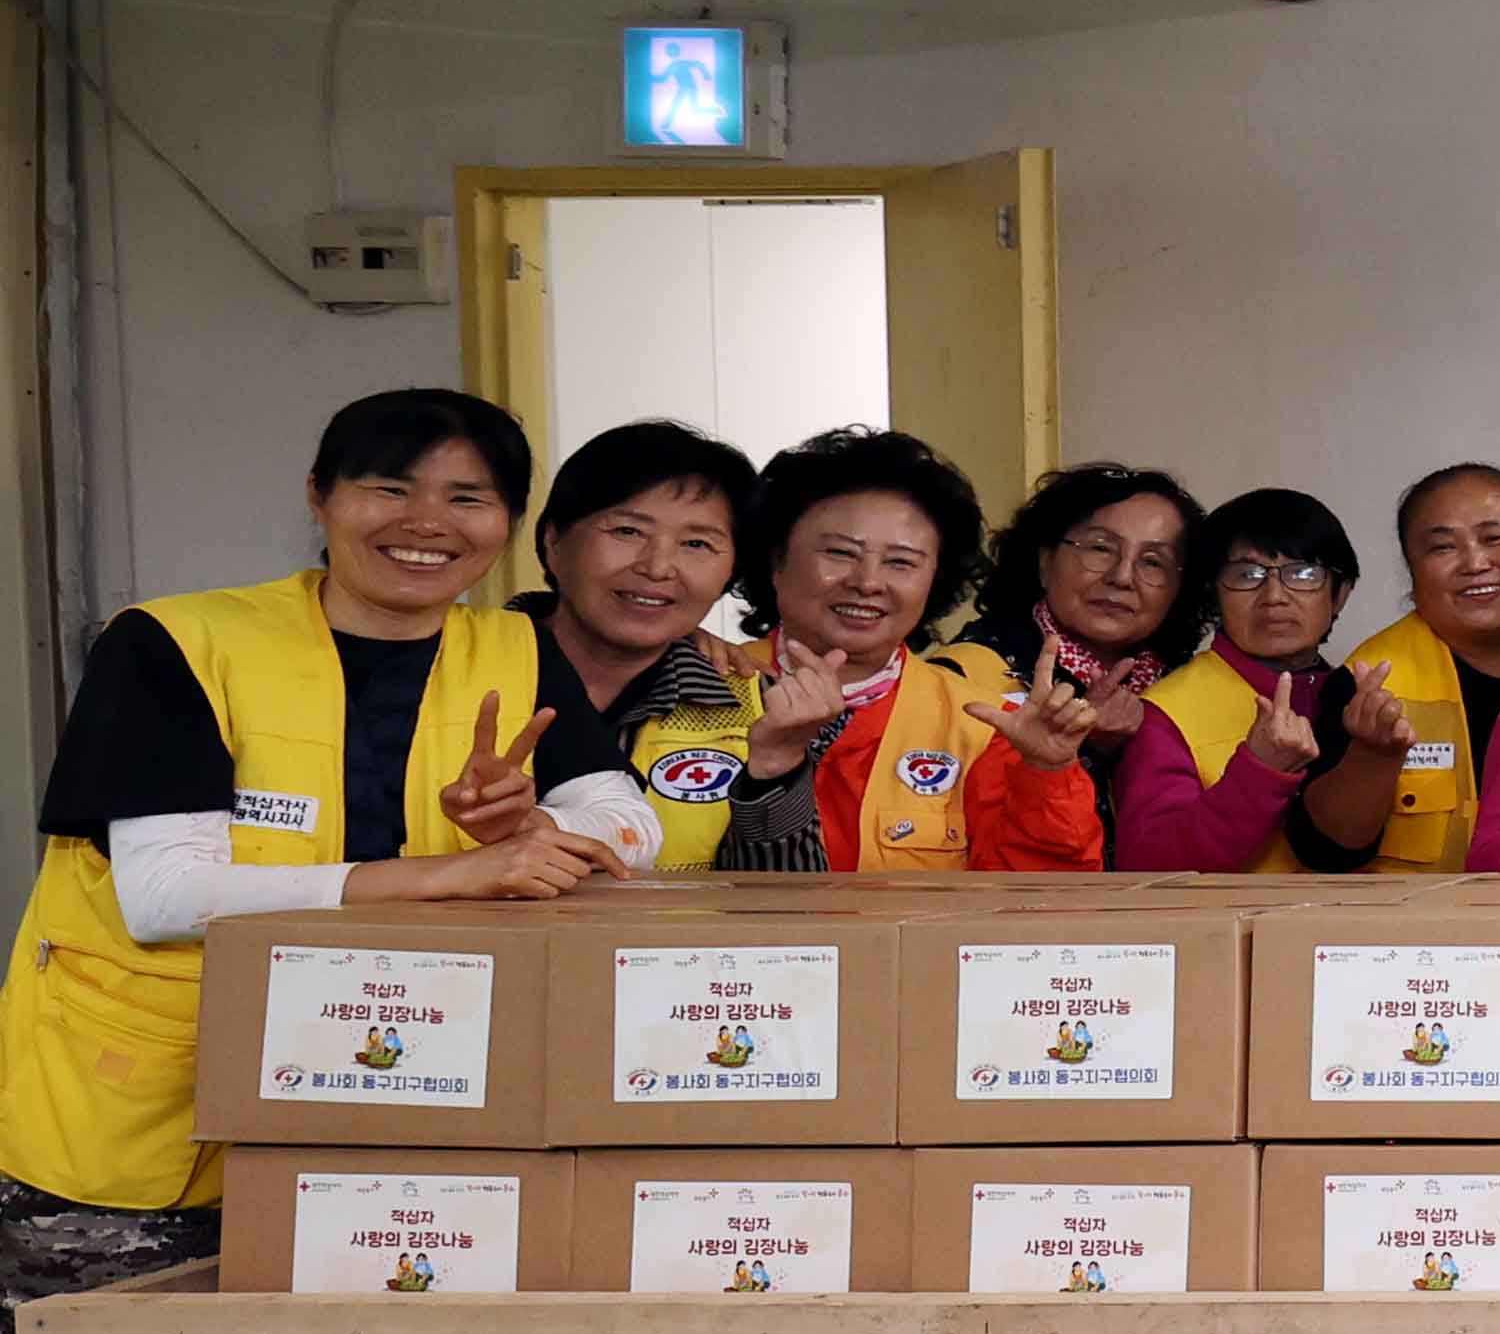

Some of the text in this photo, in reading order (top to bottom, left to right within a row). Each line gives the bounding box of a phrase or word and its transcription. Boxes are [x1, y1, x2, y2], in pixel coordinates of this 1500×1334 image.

[360, 982, 407, 999] 적십자
[1048, 976, 1093, 993] 적십자
[319, 1002, 446, 1025] 사랑의 김장나눔
[1010, 997, 1131, 1018] 사랑의 김장나눔
[310, 1072, 469, 1094] 봉사회 동구지구협의회
[1006, 1067, 1158, 1086] 봉사회 동구지구협의회
[725, 1216, 771, 1233] 적십자
[1413, 1207, 1459, 1224] 적십자
[687, 1237, 810, 1257] 사랑의 김장나눔
[1376, 1228, 1497, 1248] 사랑의 김장나눔
